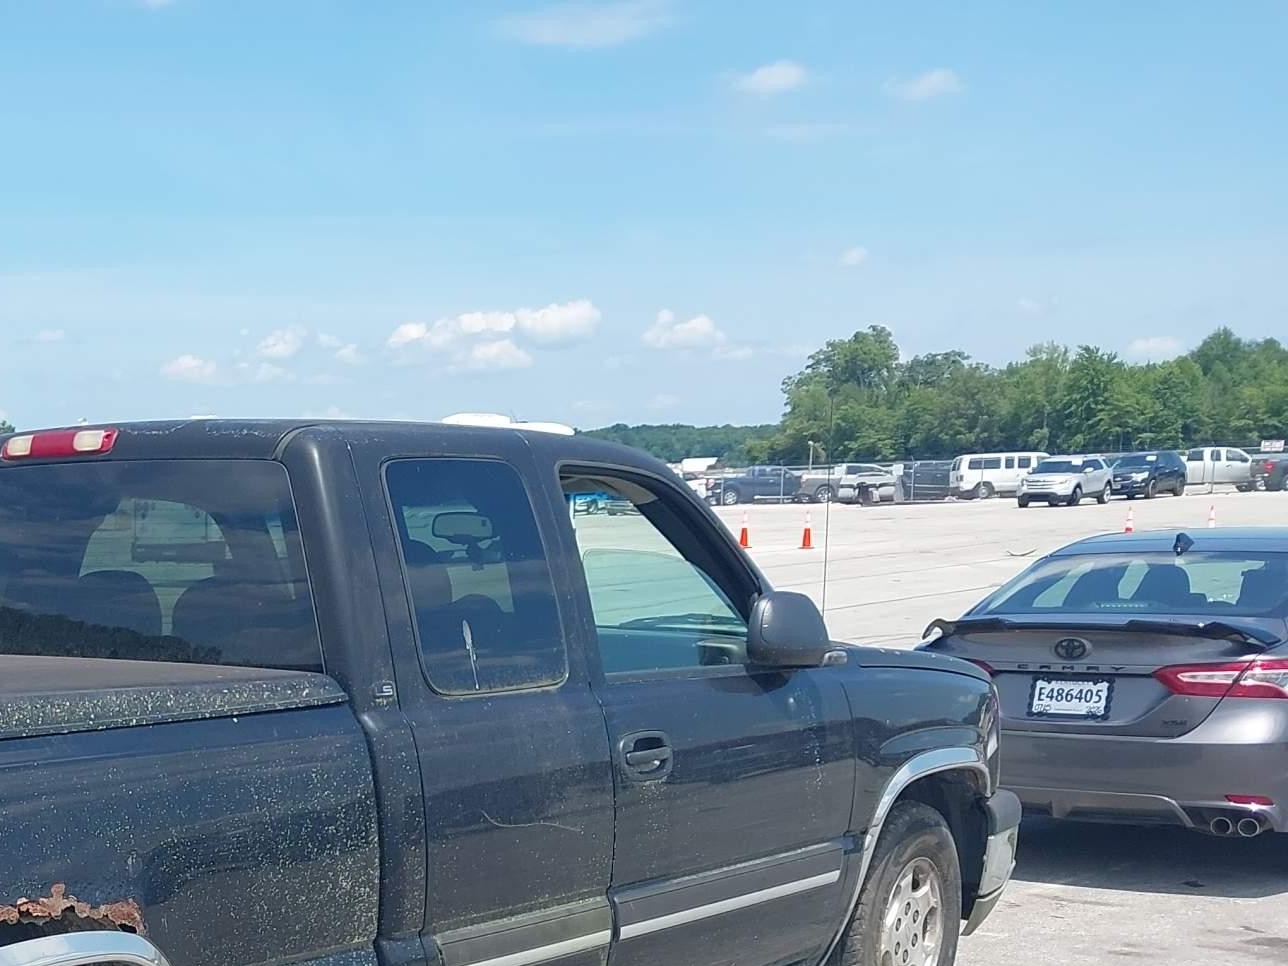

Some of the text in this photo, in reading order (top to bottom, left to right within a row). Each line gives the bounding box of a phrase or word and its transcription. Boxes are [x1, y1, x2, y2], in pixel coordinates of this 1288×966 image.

[1016, 663, 1127, 672] CAMRY
[374, 684, 394, 697] LS
[1037, 686, 1104, 704] E486405
